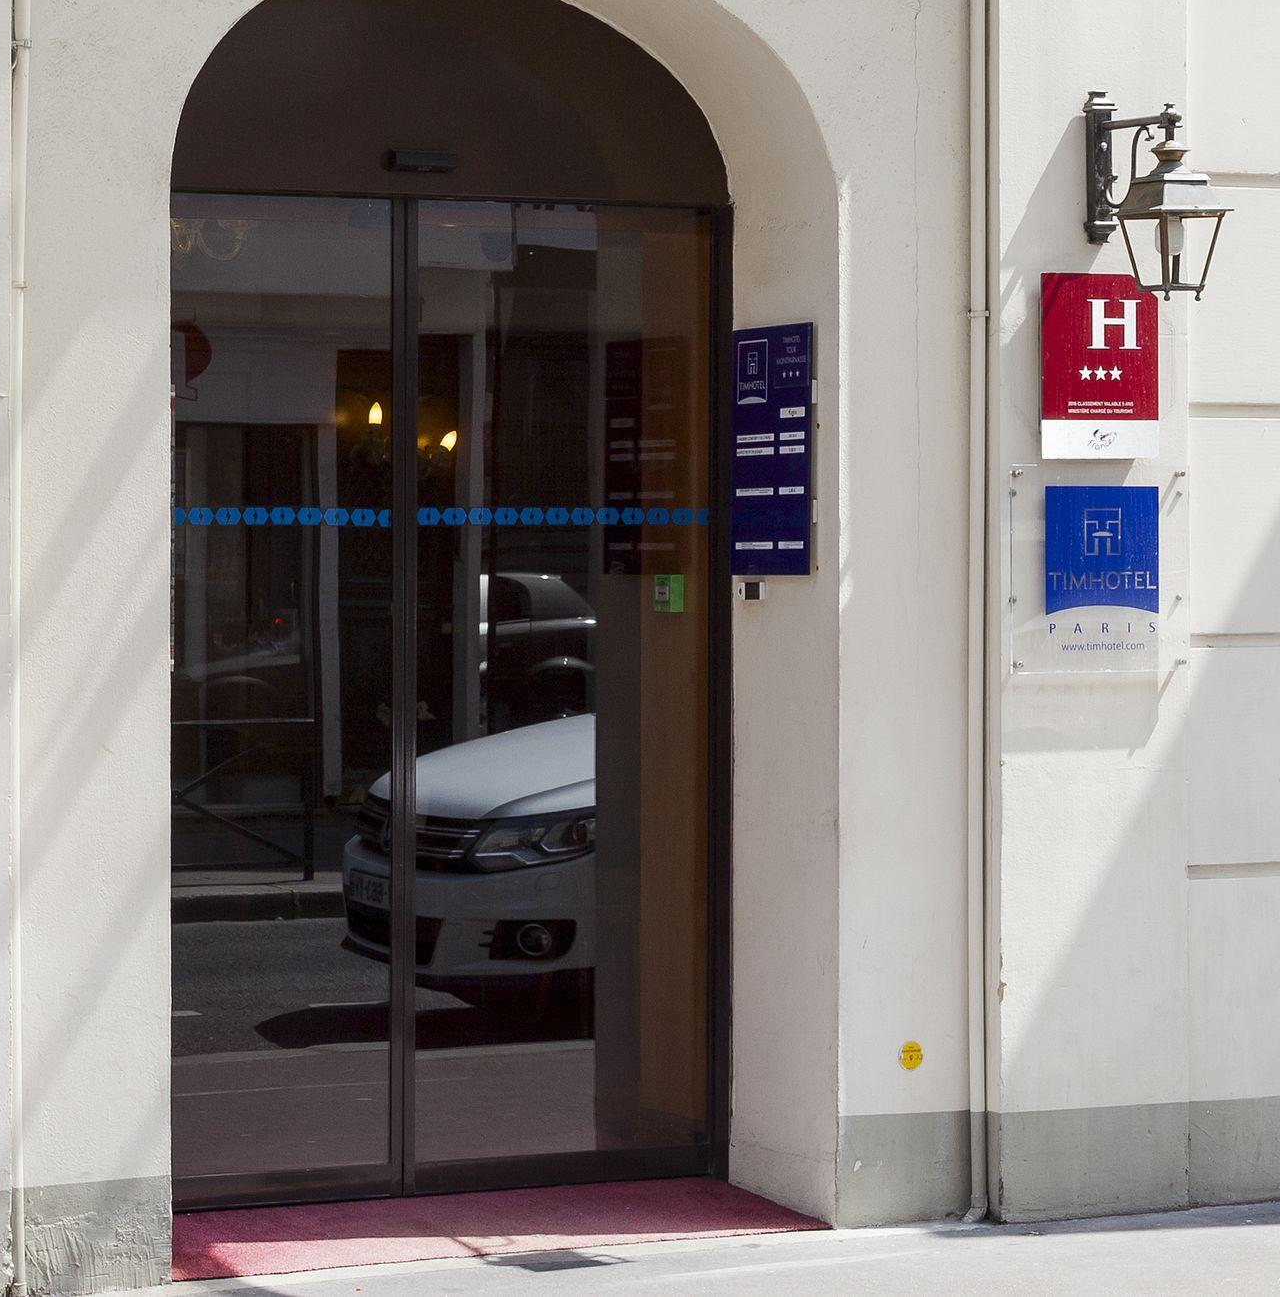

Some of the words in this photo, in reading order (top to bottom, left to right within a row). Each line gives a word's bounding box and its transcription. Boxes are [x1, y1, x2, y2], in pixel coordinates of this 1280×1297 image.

[1086, 298, 1142, 350] H
[1048, 572, 1157, 591] TIMHOTEL
[1049, 622, 1157, 634] PARIS
[1061, 641, 1145, 652] www.timhotel.com
